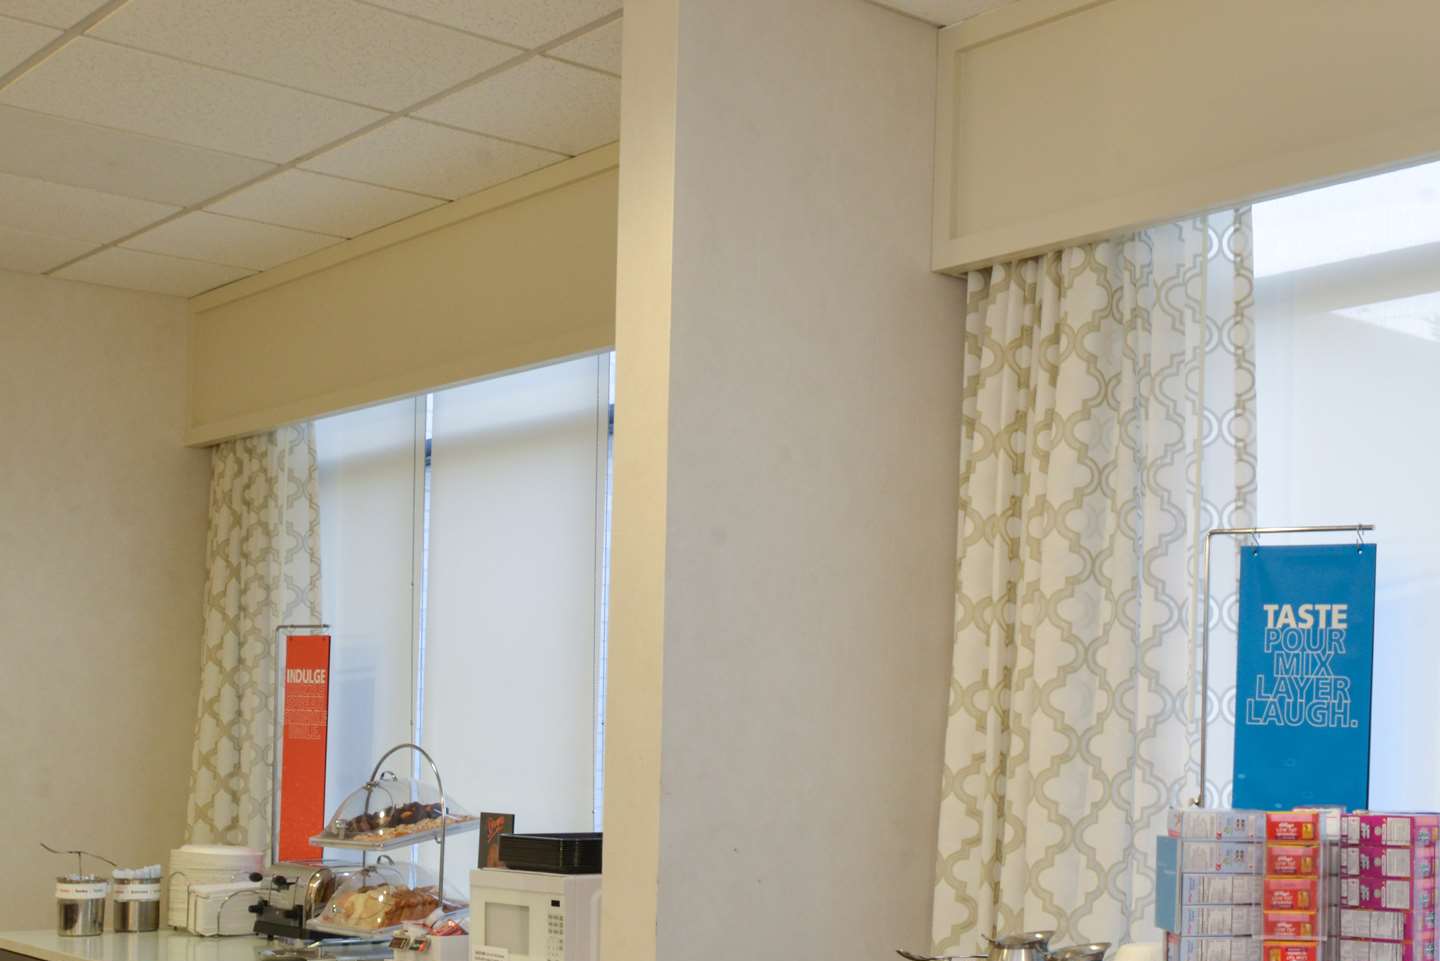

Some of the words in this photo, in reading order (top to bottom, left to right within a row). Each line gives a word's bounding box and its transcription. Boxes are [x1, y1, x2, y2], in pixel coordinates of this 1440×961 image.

[1263, 604, 1348, 629] TASTE
[1264, 627, 1347, 654] POUR
[286, 668, 326, 684] INDULGE
[1273, 651, 1335, 678] MIX
[1256, 675, 1352, 702] LAYER
[1245, 699, 1359, 728] LAUGH.
